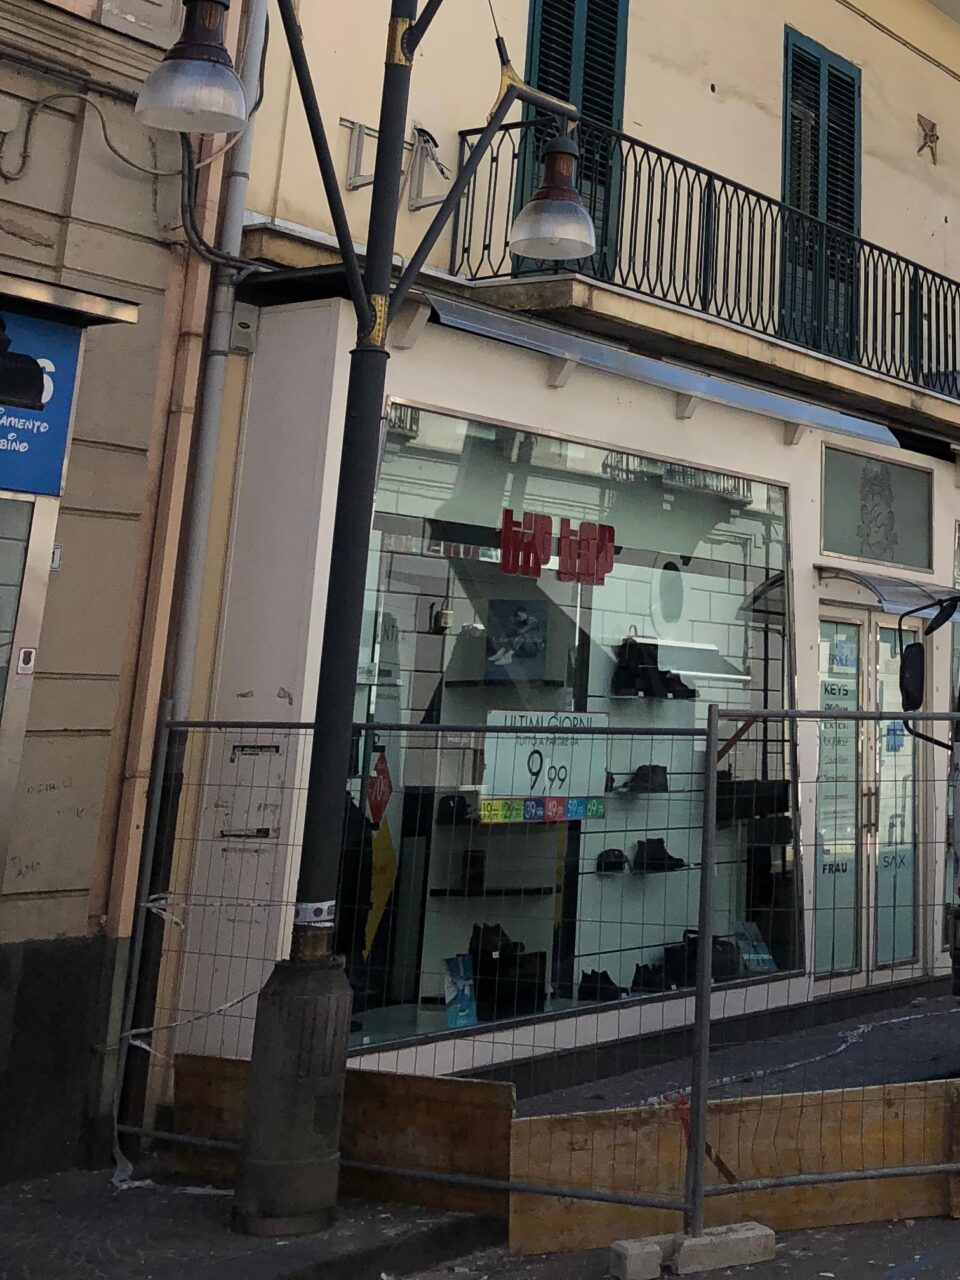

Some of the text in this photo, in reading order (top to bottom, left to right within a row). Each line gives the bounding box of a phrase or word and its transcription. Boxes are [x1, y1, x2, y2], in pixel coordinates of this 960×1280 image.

[0, 414, 49, 434] AMENTO
[824, 683, 849, 696] KEYS
[822, 863, 848, 875] FRAU
